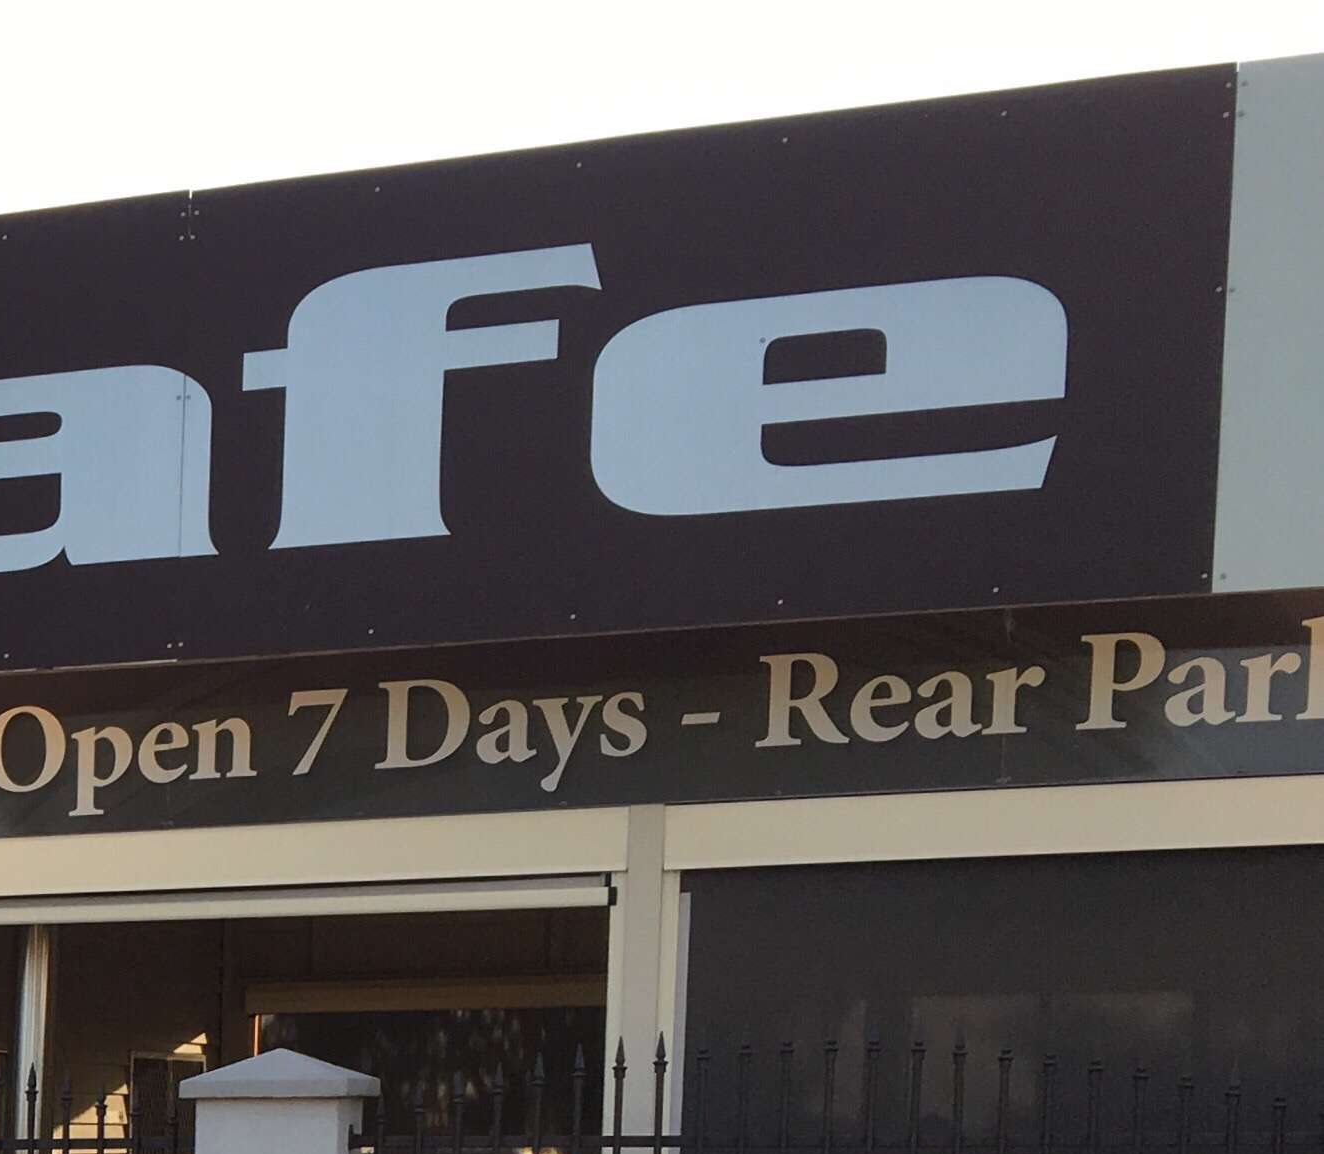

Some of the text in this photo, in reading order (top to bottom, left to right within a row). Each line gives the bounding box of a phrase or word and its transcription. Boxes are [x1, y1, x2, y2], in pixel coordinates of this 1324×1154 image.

[288, 689, 348, 772] 7
[375, 680, 647, 792] Days
[755, 654, 1045, 747] Rear
